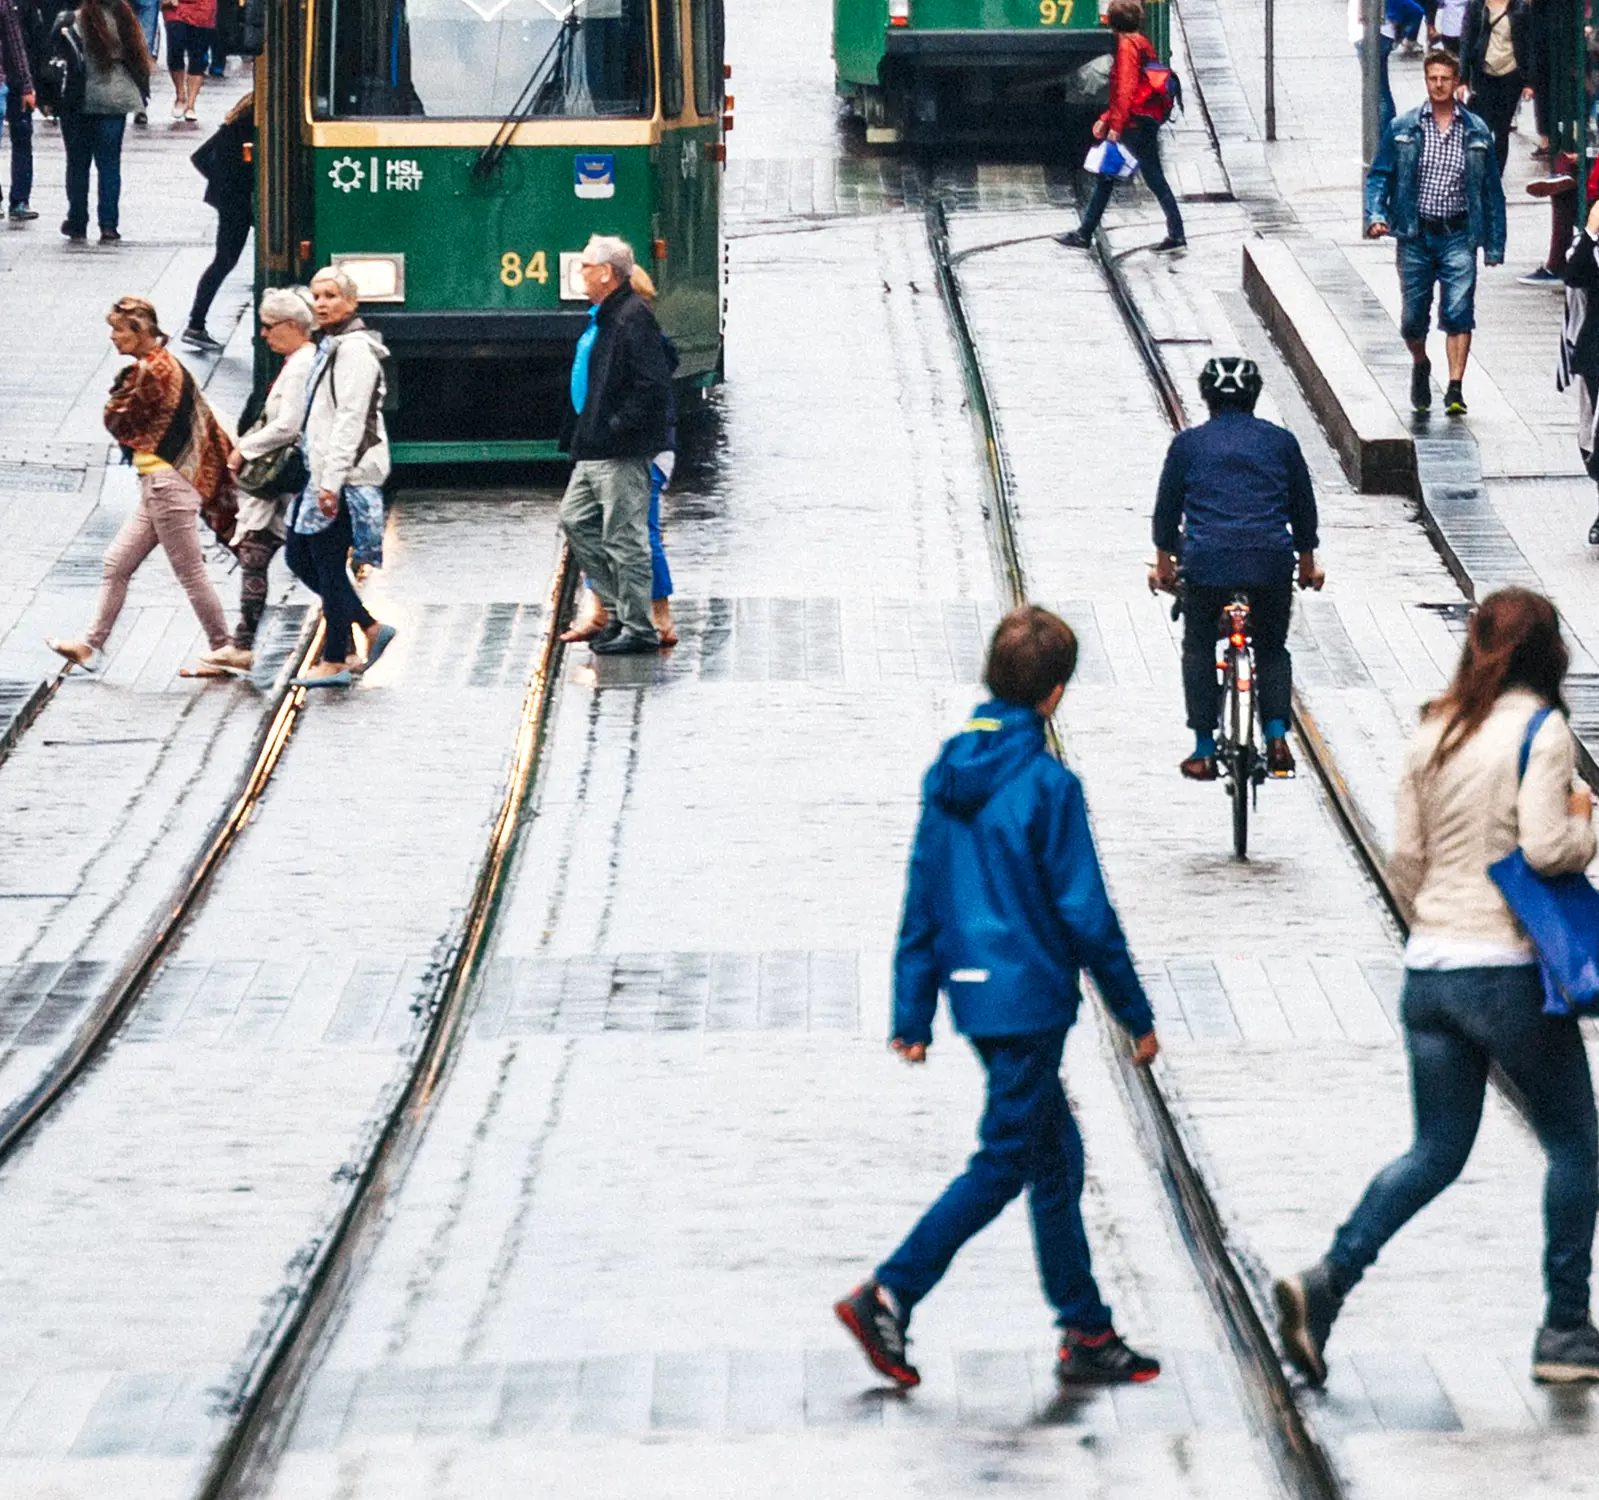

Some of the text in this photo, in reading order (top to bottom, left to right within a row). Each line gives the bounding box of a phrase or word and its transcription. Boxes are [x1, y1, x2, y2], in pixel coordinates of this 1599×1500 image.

[1040, 0, 1074, 24] 97
[386, 160, 423, 174] HSL
[386, 175, 422, 190] HRT
[499, 253, 549, 287] 84
